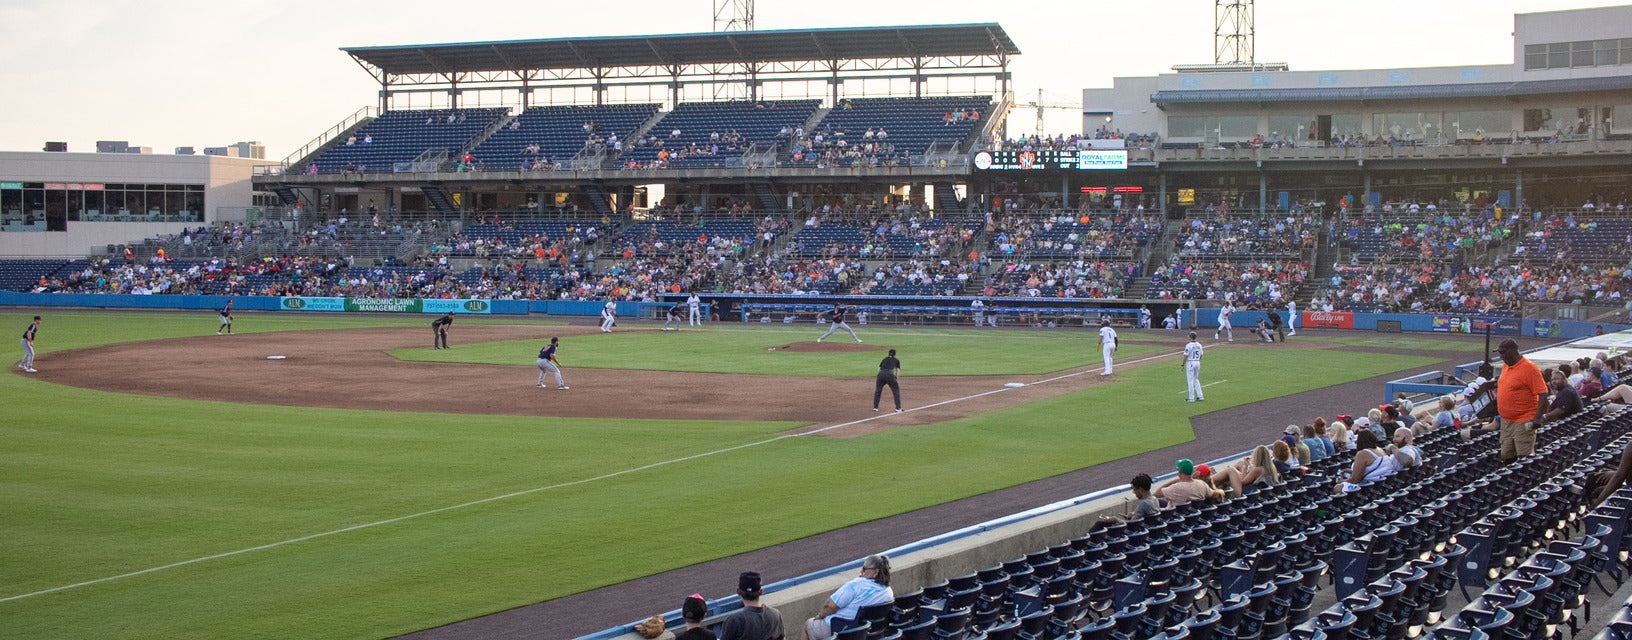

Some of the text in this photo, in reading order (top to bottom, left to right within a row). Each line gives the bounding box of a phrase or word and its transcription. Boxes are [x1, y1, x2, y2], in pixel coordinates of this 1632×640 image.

[288, 298, 301, 308] ALM
[395, 298, 415, 306] LAWN
[469, 301, 482, 311] ALM
[359, 304, 407, 312] MANAGEMENT
[1311, 311, 1333, 323] Bally
[1191, 350, 1200, 360] 15
